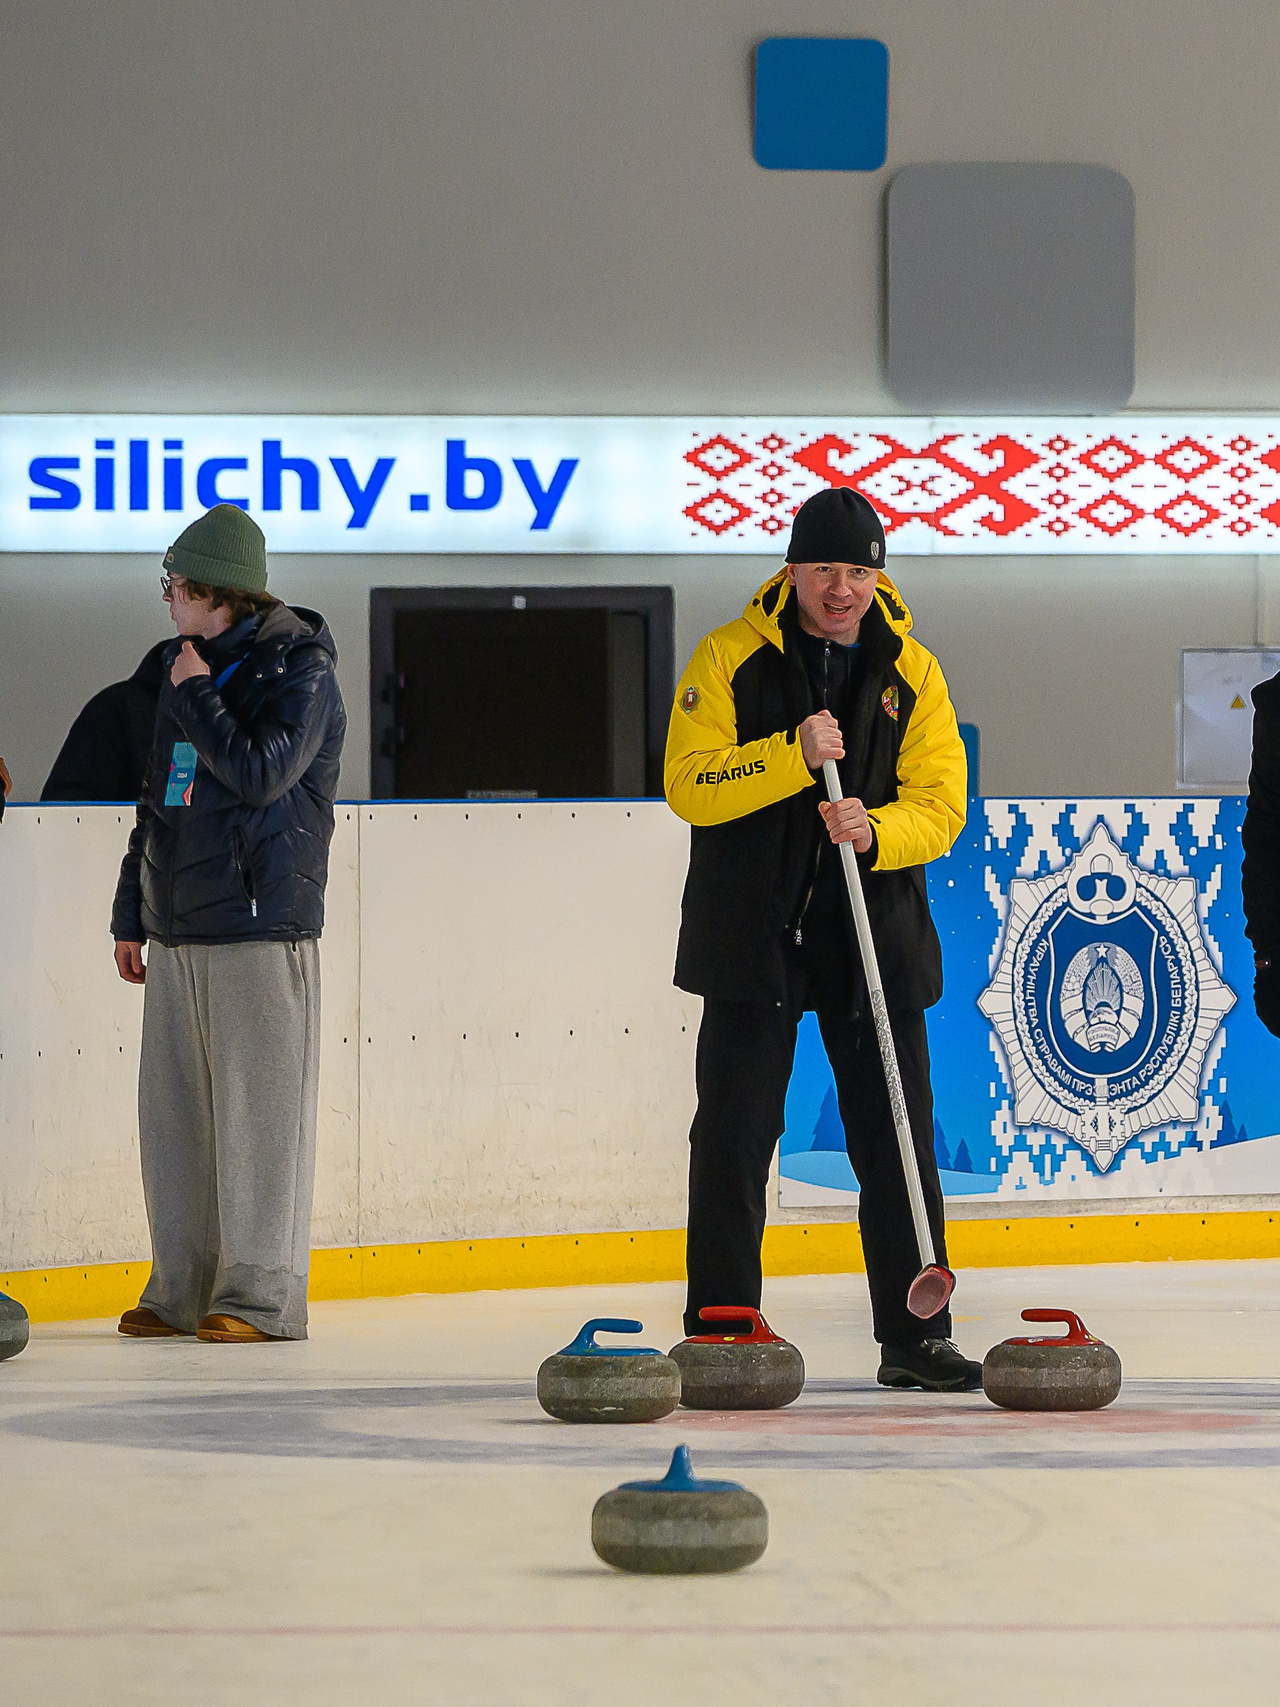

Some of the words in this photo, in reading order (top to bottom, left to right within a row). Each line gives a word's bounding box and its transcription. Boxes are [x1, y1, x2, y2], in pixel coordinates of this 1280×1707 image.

[28, 439, 580, 531] silichy.by
[695, 759, 766, 785] BELARUS
[1159, 935, 1183, 1008] БЕЛАРУСЬ
[1033, 1028, 1072, 1085] СПРАВАМІ
[1138, 1010, 1182, 1082] РЭСПУБЛІКІ
[1071, 1075, 1141, 1098] ПРЭЭНТА
